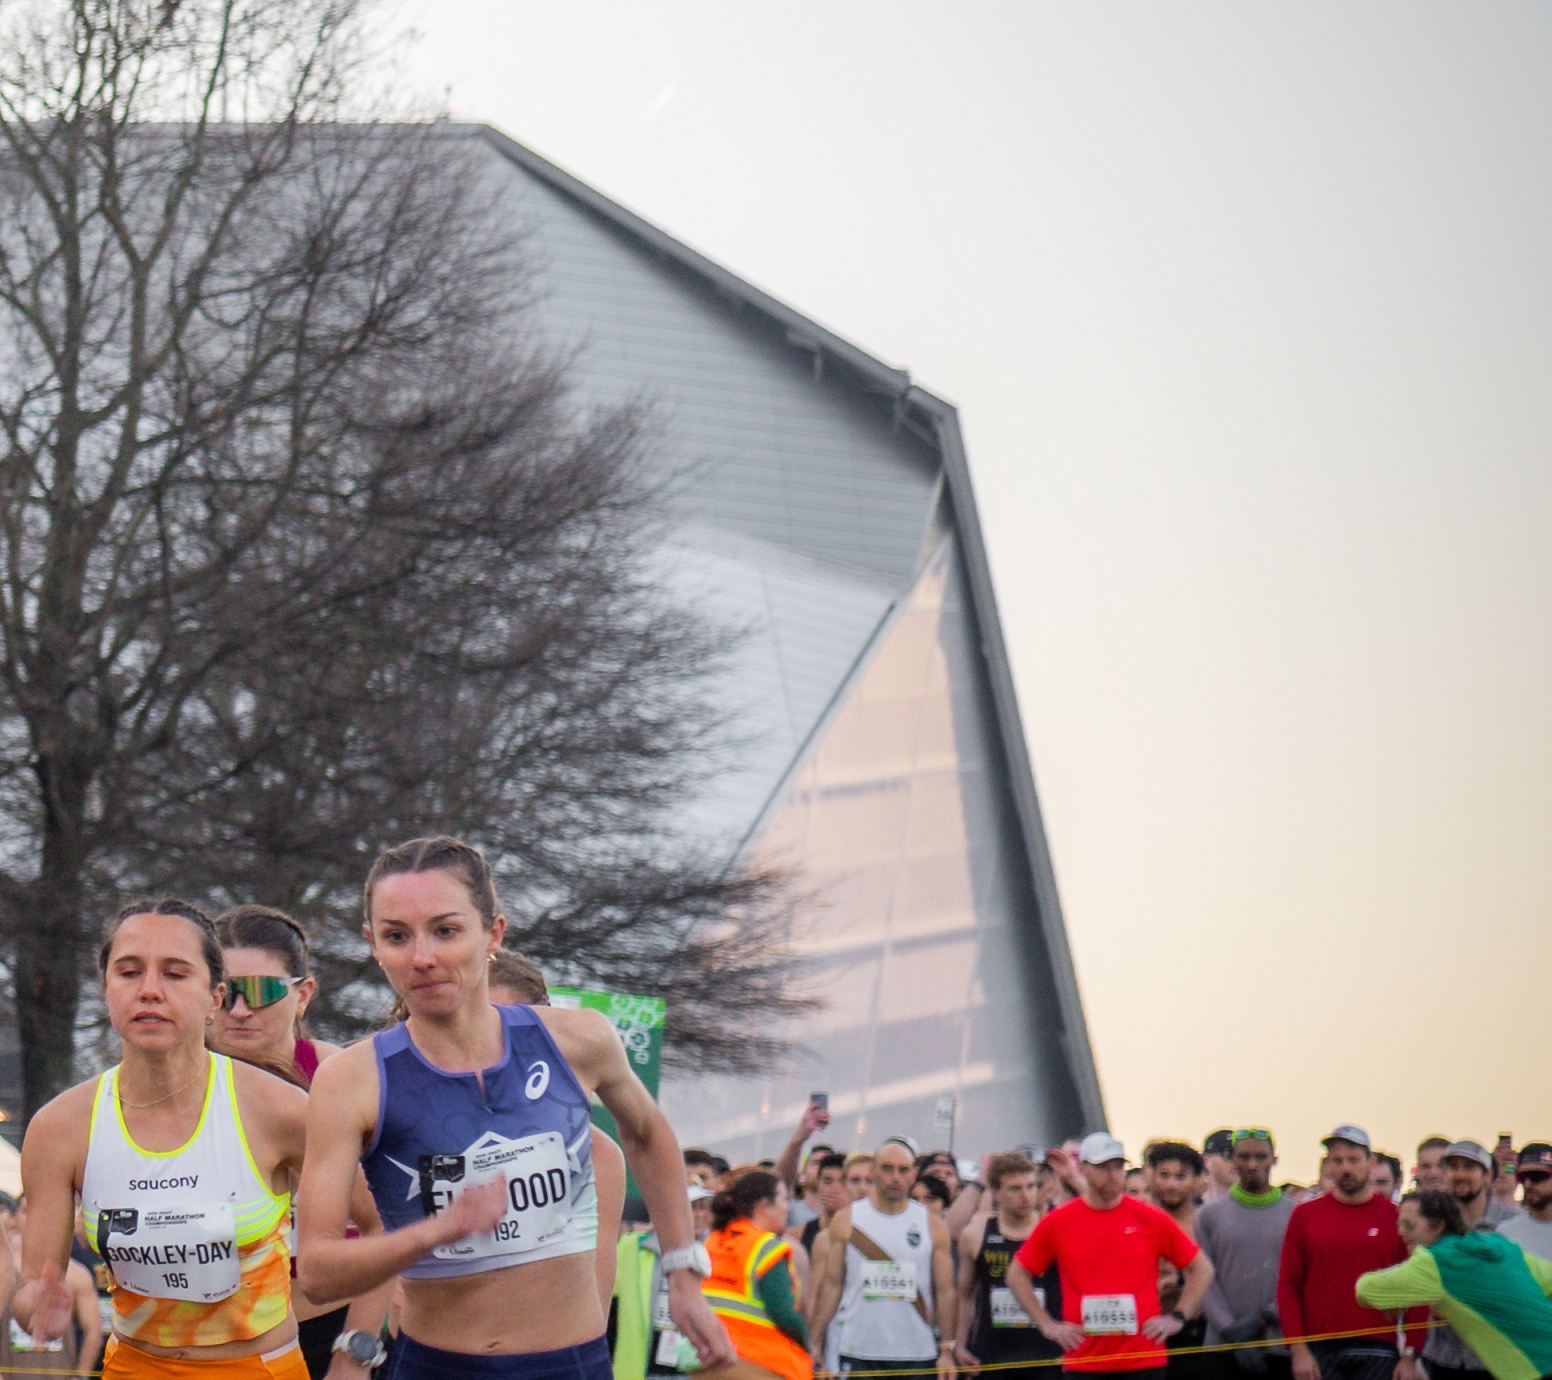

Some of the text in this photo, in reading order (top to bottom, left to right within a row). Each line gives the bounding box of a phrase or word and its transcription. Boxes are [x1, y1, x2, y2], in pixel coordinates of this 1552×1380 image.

[129, 1175, 199, 1190] saucony
[494, 1220, 521, 1242] 192
[107, 1241, 232, 1266] GOCKLEY-DAY
[162, 1273, 189, 1289] 195
